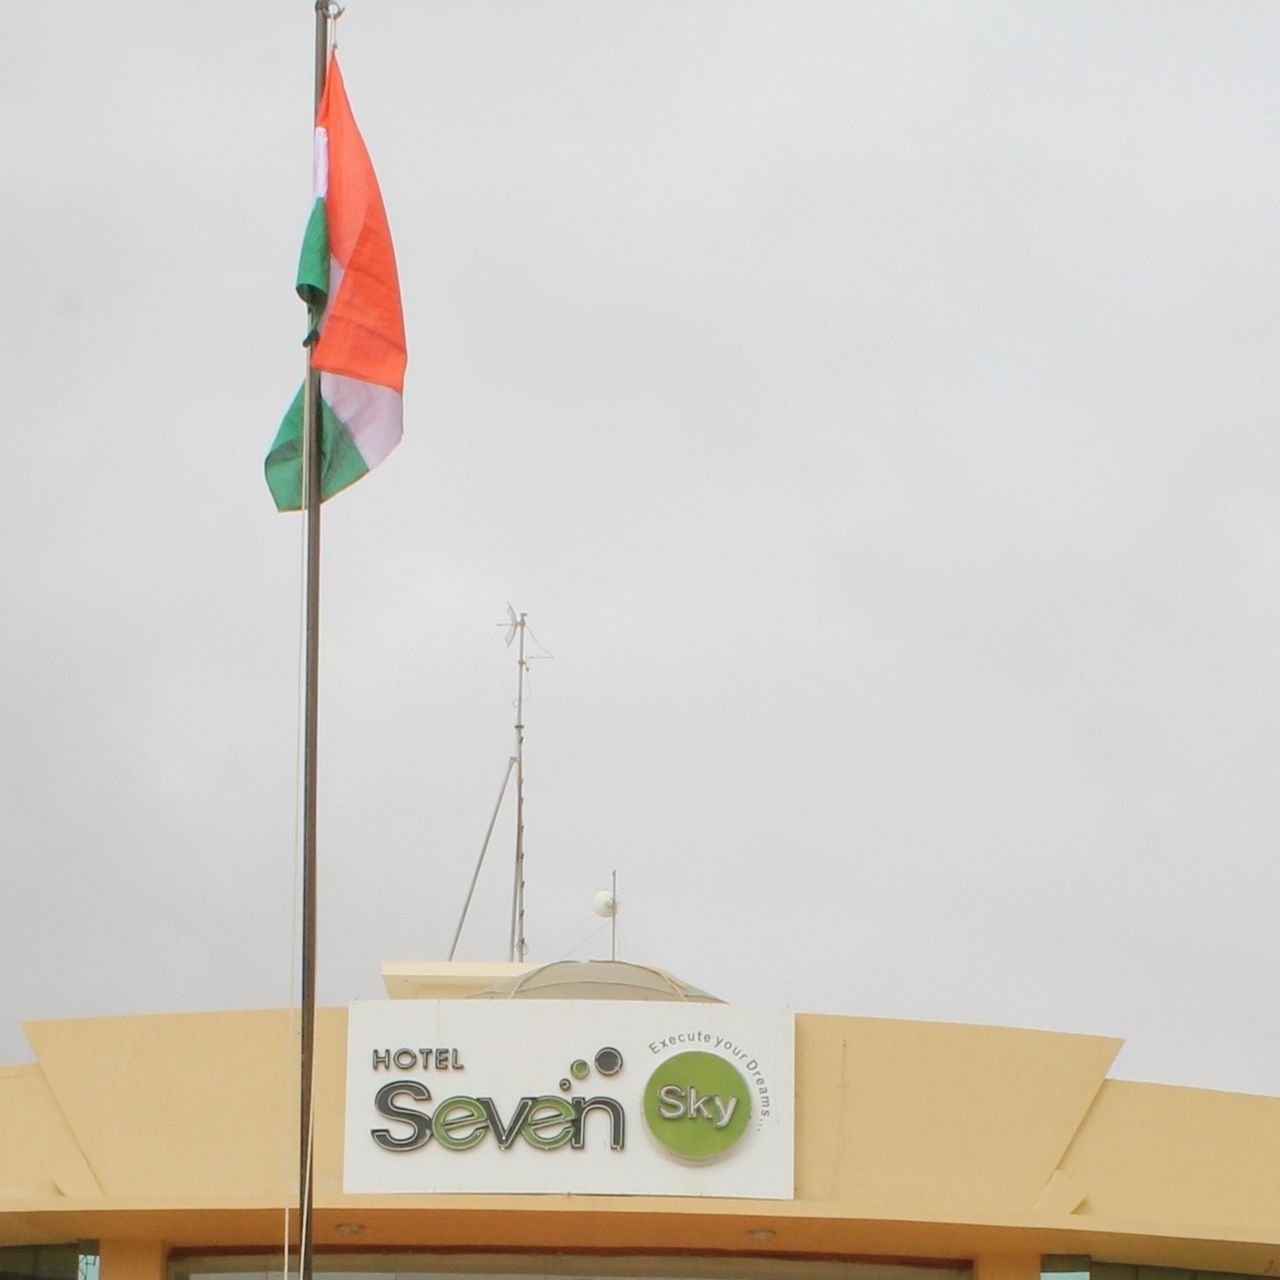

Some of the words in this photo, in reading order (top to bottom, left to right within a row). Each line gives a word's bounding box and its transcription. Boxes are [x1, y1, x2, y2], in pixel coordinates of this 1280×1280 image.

[372, 1047, 464, 1071] HOTEL
[648, 1031, 711, 1055] Execute
[714, 1036, 748, 1061] your
[370, 1080, 625, 1152] Seven
[656, 1083, 739, 1129] Sky
